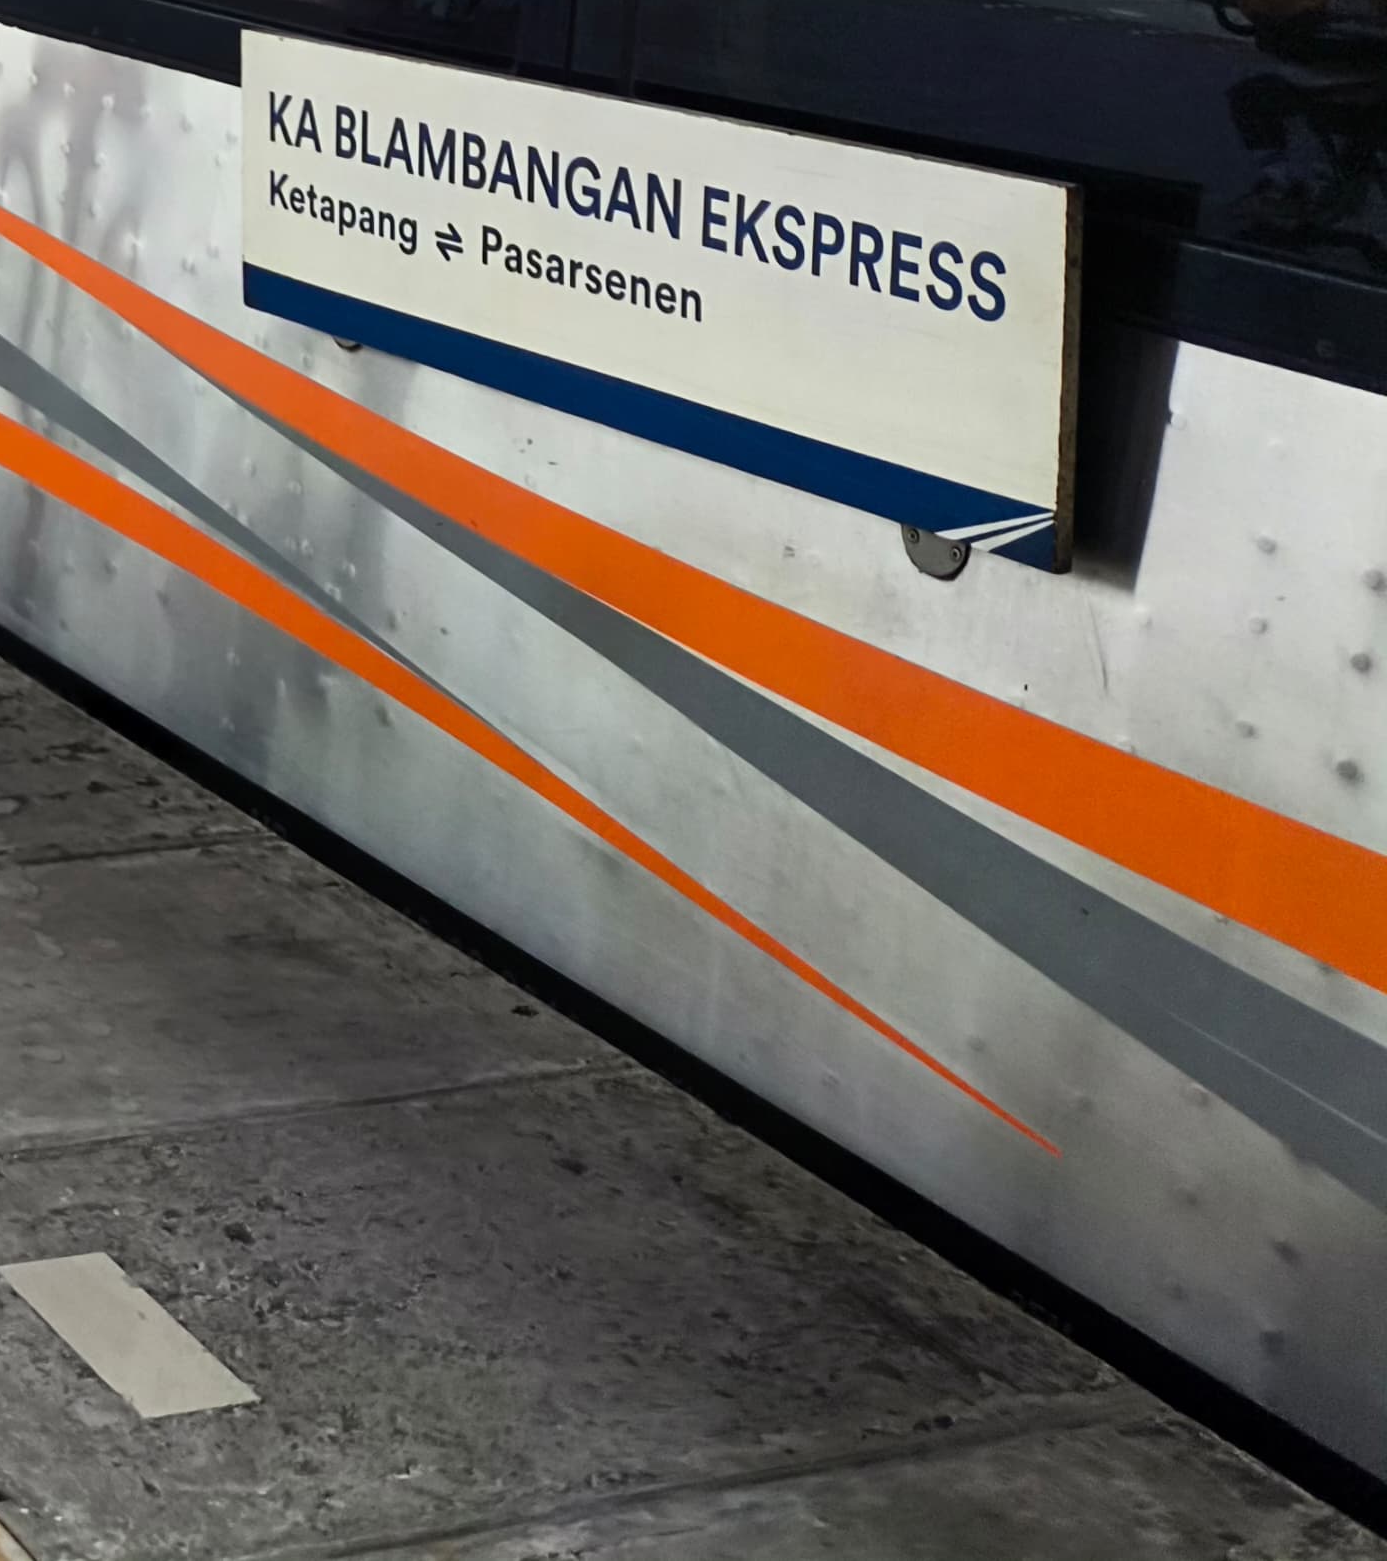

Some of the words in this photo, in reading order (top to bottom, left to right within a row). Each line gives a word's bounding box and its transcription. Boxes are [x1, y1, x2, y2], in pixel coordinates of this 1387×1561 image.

[269, 90, 323, 154] KA
[334, 104, 682, 240] BLAMBANGAN
[701, 185, 1007, 323] EKSPRESS
[269, 169, 418, 256] Ketapang
[481, 225, 702, 323] Pasarsenen
